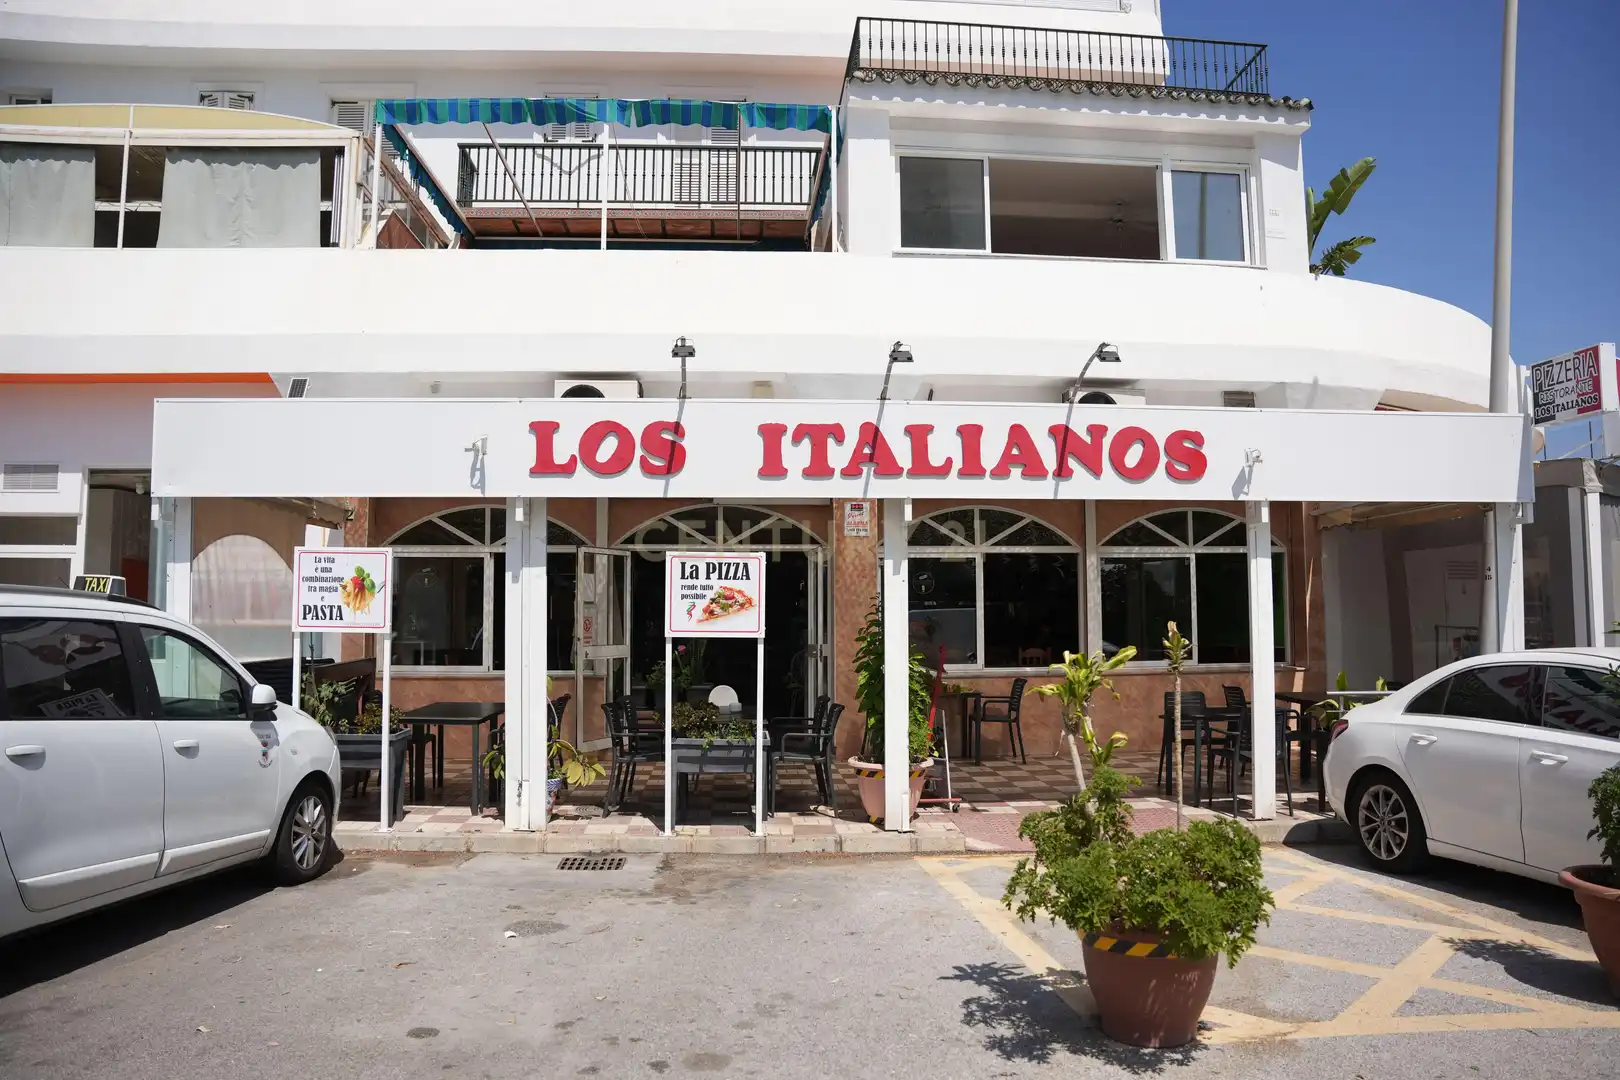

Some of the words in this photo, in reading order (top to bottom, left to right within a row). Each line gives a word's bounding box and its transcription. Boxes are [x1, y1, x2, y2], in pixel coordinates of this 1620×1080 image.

[1533, 351, 1598, 393] PIZZERIA
[1539, 380, 1592, 404] RISTORANTE
[1535, 404, 1552, 418] LOS
[1552, 393, 1598, 414] ITALIANOS
[529, 420, 687, 476] LOS
[757, 421, 1208, 481] ITALIANOS
[314, 556, 322, 564] La
[323, 556, 335, 564] vita
[301, 575, 345, 583] combinazione
[680, 561, 700, 580] La
[705, 561, 751, 581] PIZZA
[84, 577, 110, 593] TAXI
[318, 585, 339, 593] magia
[680, 583, 698, 591] rende
[699, 583, 714, 591] tutto
[680, 593, 707, 601] possibile
[302, 604, 344, 621] PASTA
